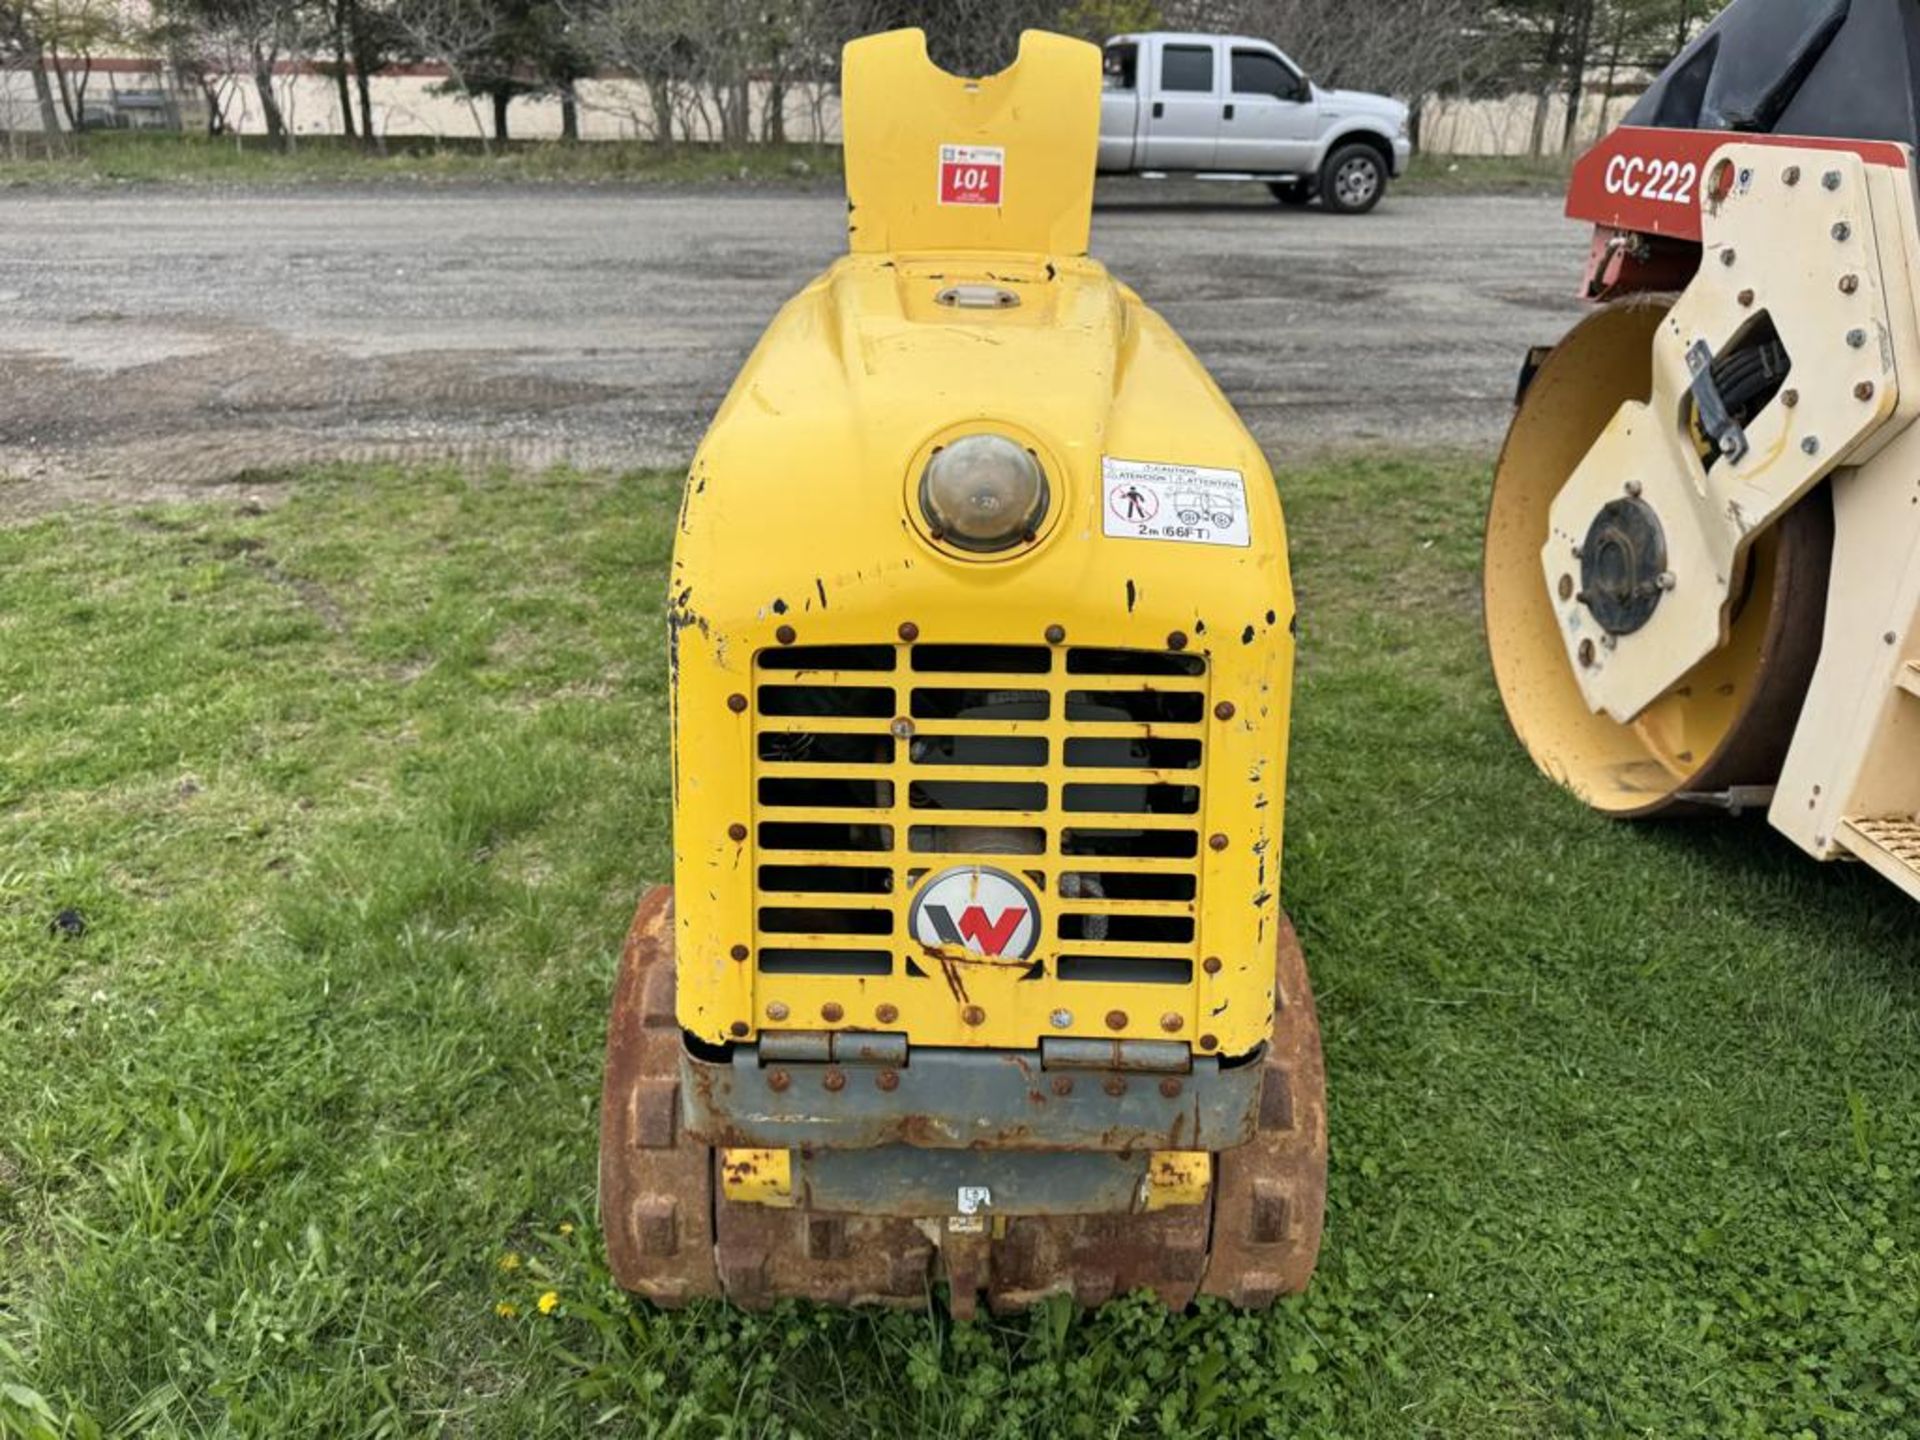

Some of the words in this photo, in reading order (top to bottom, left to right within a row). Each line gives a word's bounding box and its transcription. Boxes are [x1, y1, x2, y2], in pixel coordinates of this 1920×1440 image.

[953, 168, 989, 190] 101
[1604, 154, 1697, 204] CC222
[1153, 466, 1197, 475] CAUTION
[1187, 478, 1239, 489] ATTENTION
